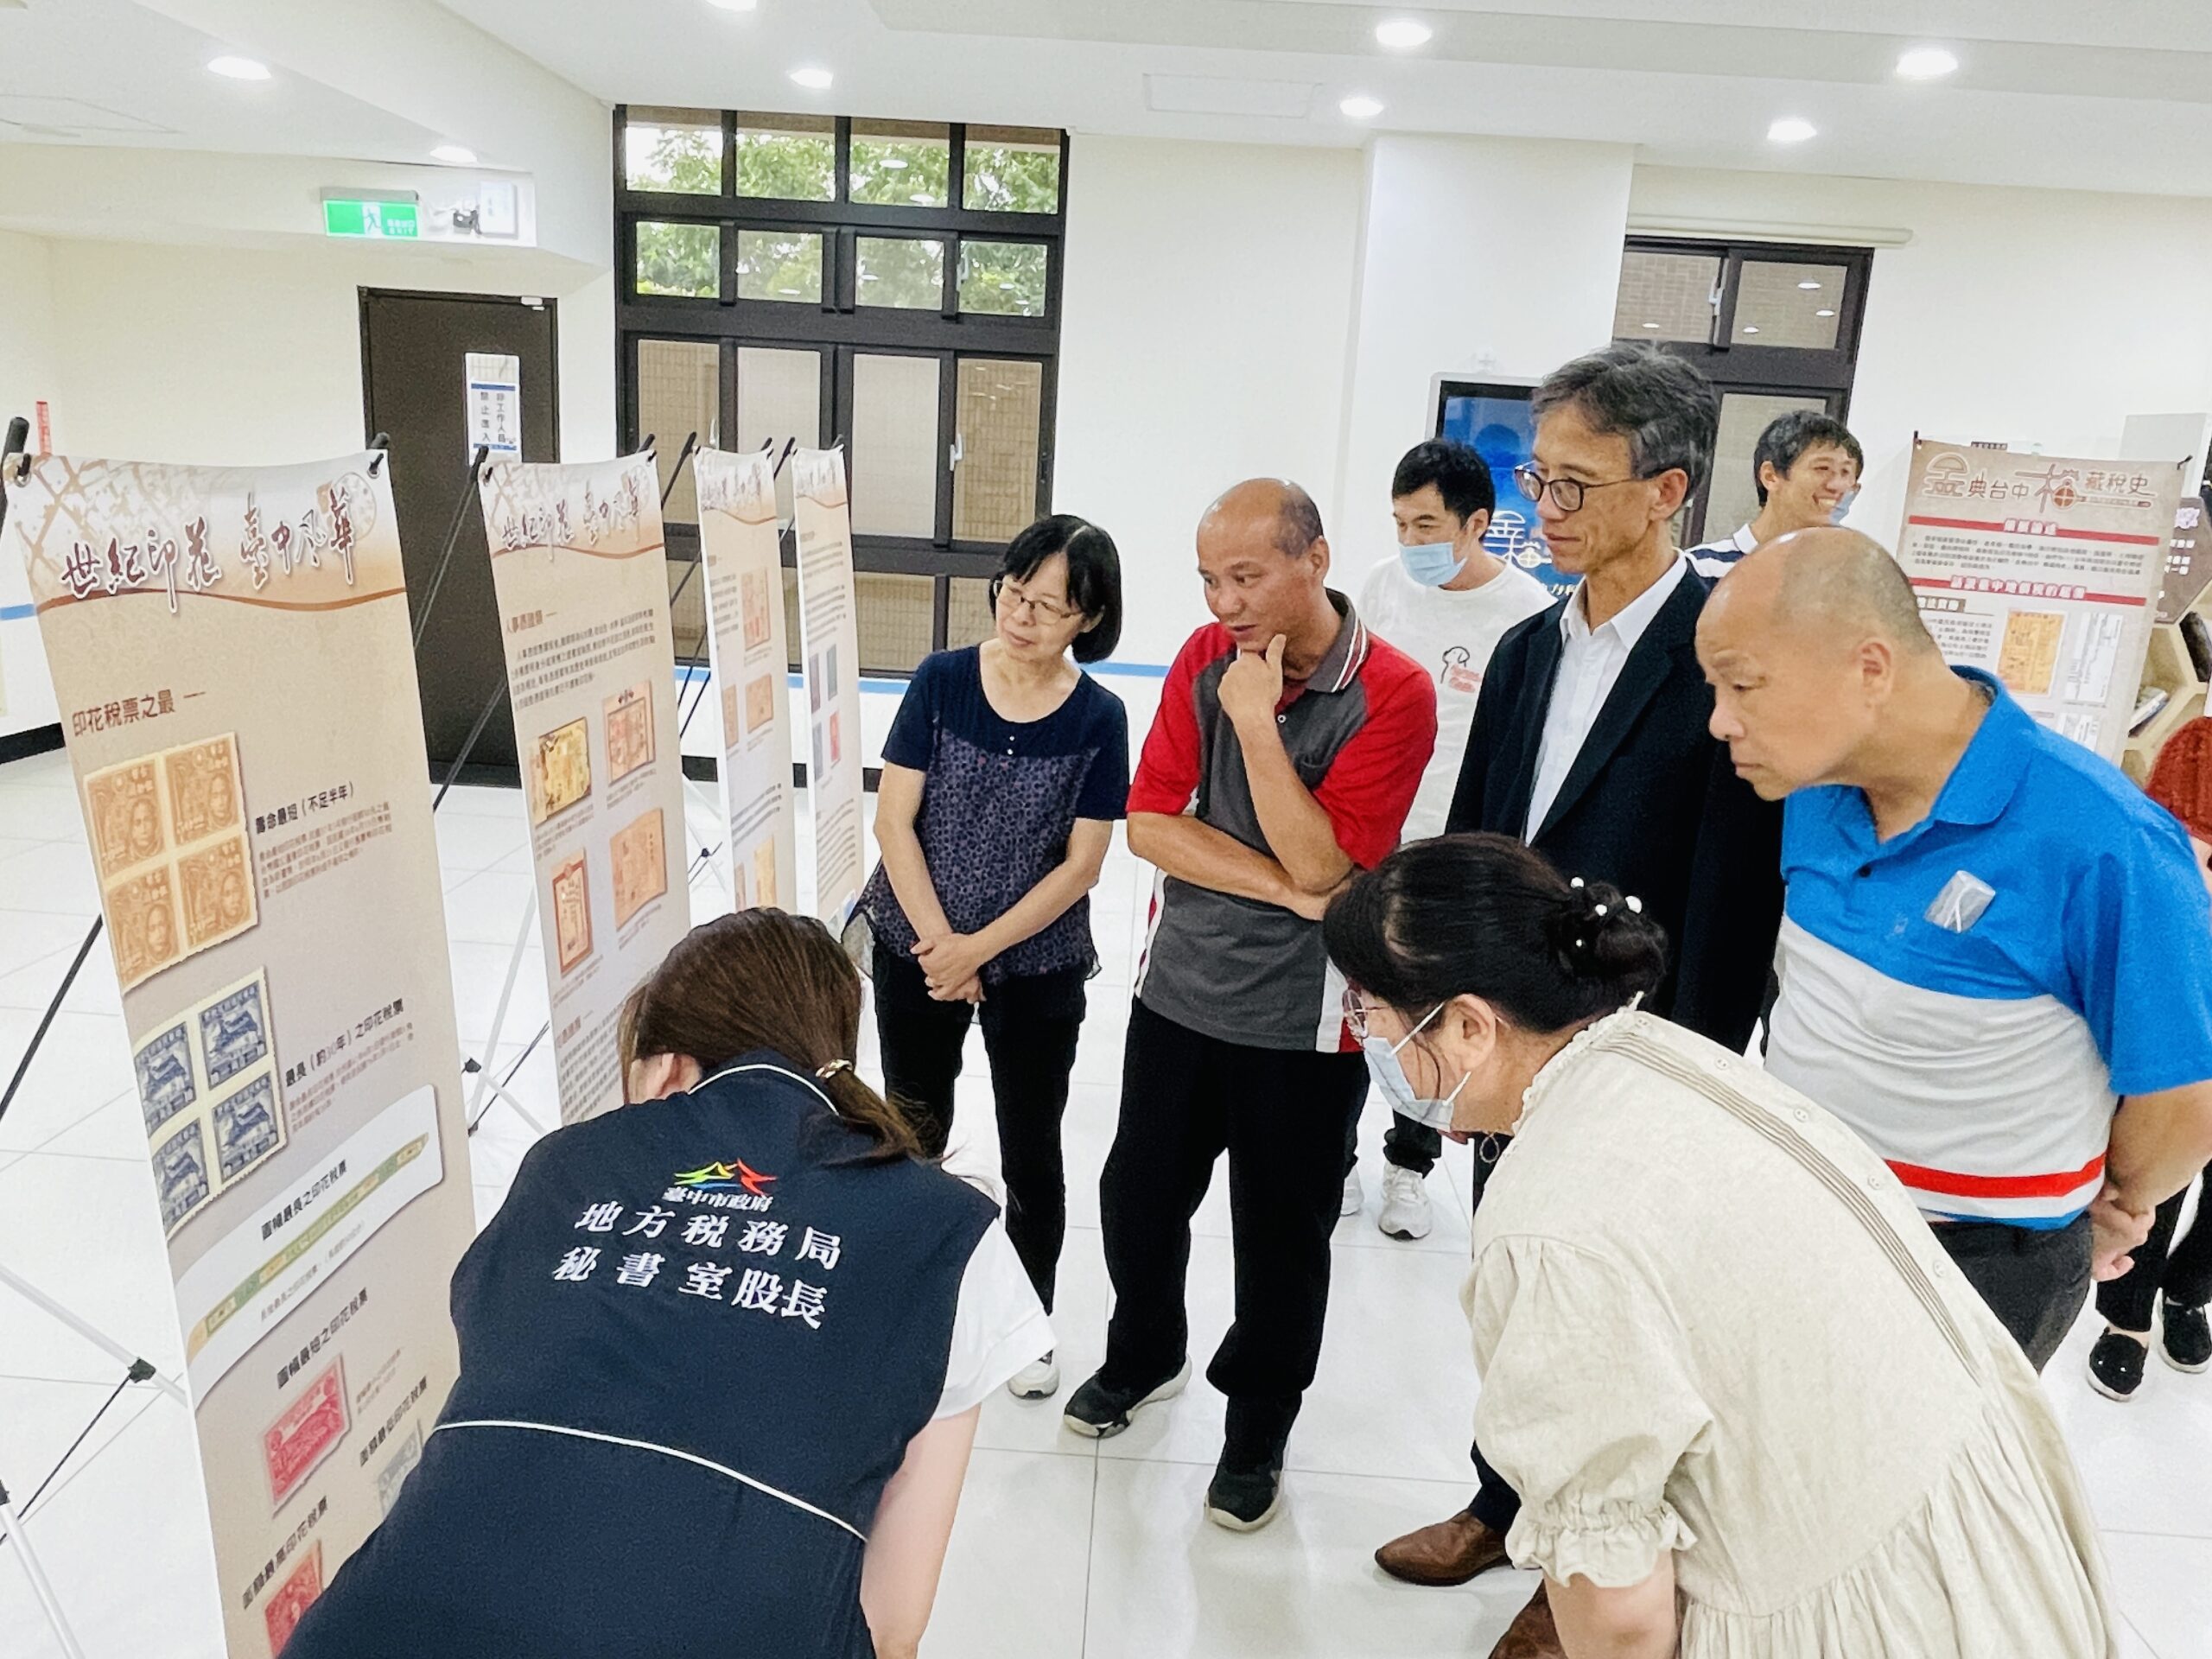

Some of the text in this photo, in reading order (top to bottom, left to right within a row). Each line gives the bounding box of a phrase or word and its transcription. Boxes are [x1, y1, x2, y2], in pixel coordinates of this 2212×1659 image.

[72, 690, 175, 736] 印花稅票之最
[552, 1246, 828, 1330] 秘書室股長
